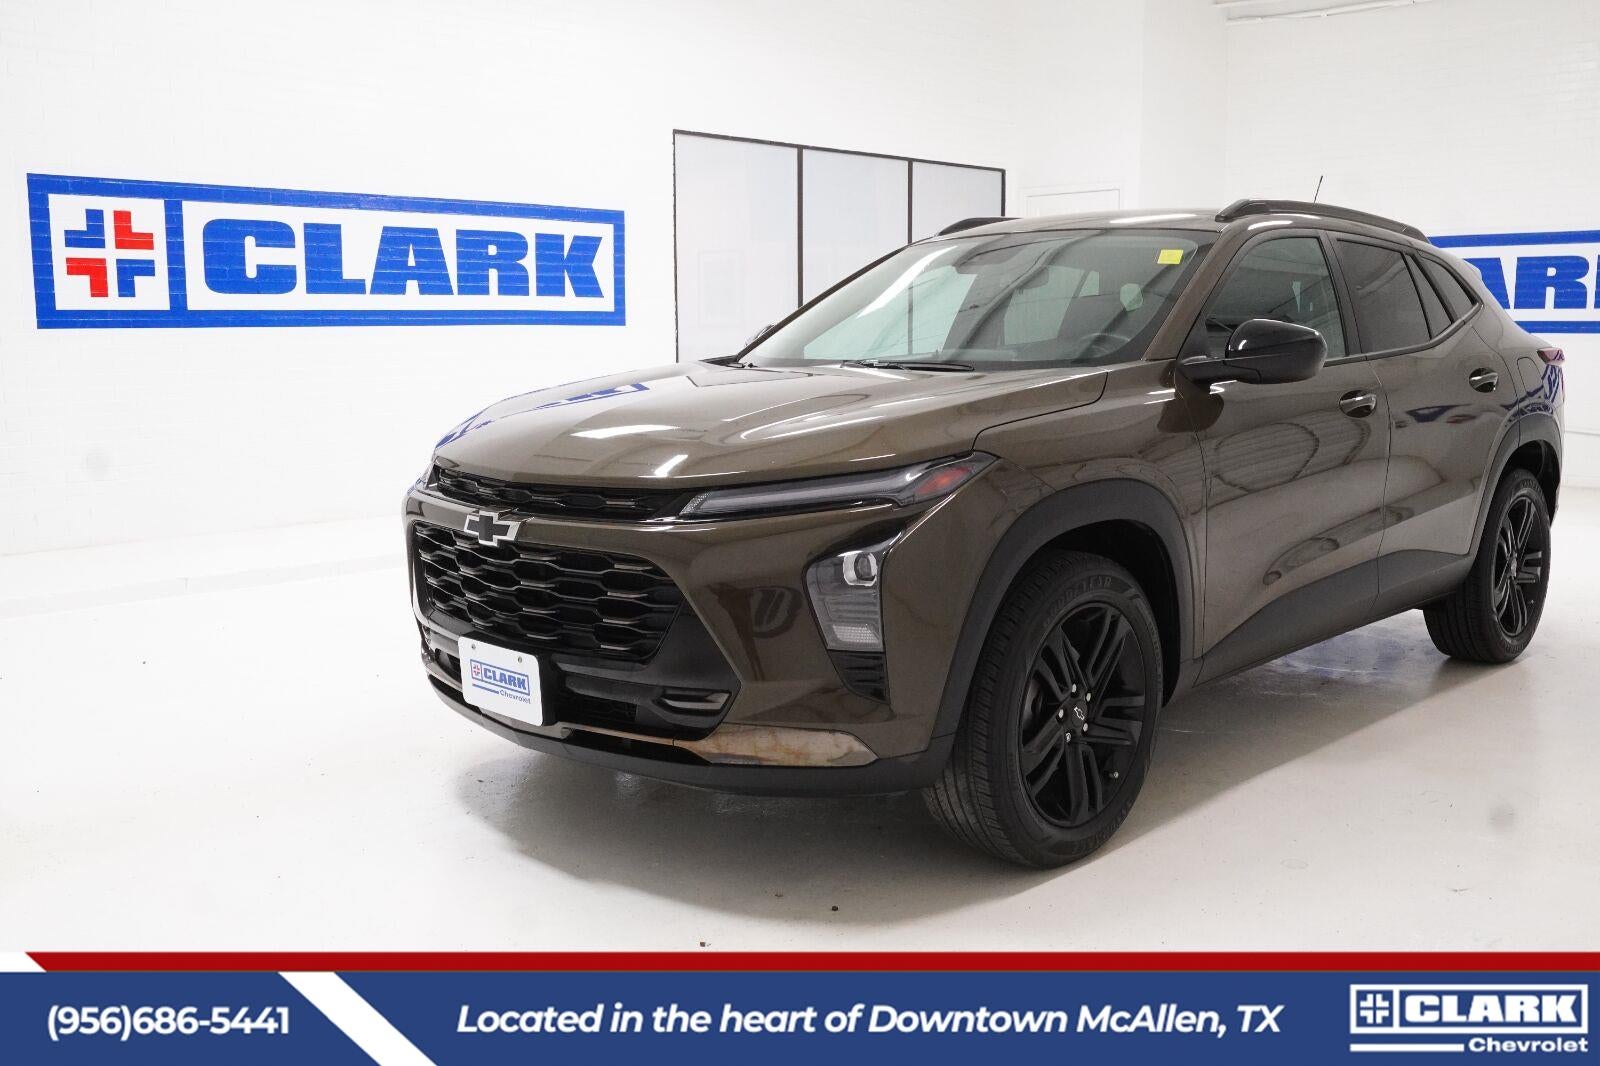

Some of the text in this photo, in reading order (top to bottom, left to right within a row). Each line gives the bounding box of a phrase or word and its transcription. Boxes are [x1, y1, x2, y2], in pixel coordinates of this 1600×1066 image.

[202, 218, 604, 298] CLARK
[483, 667, 527, 690] CLARK
[500, 690, 531, 704] Chevrolet
